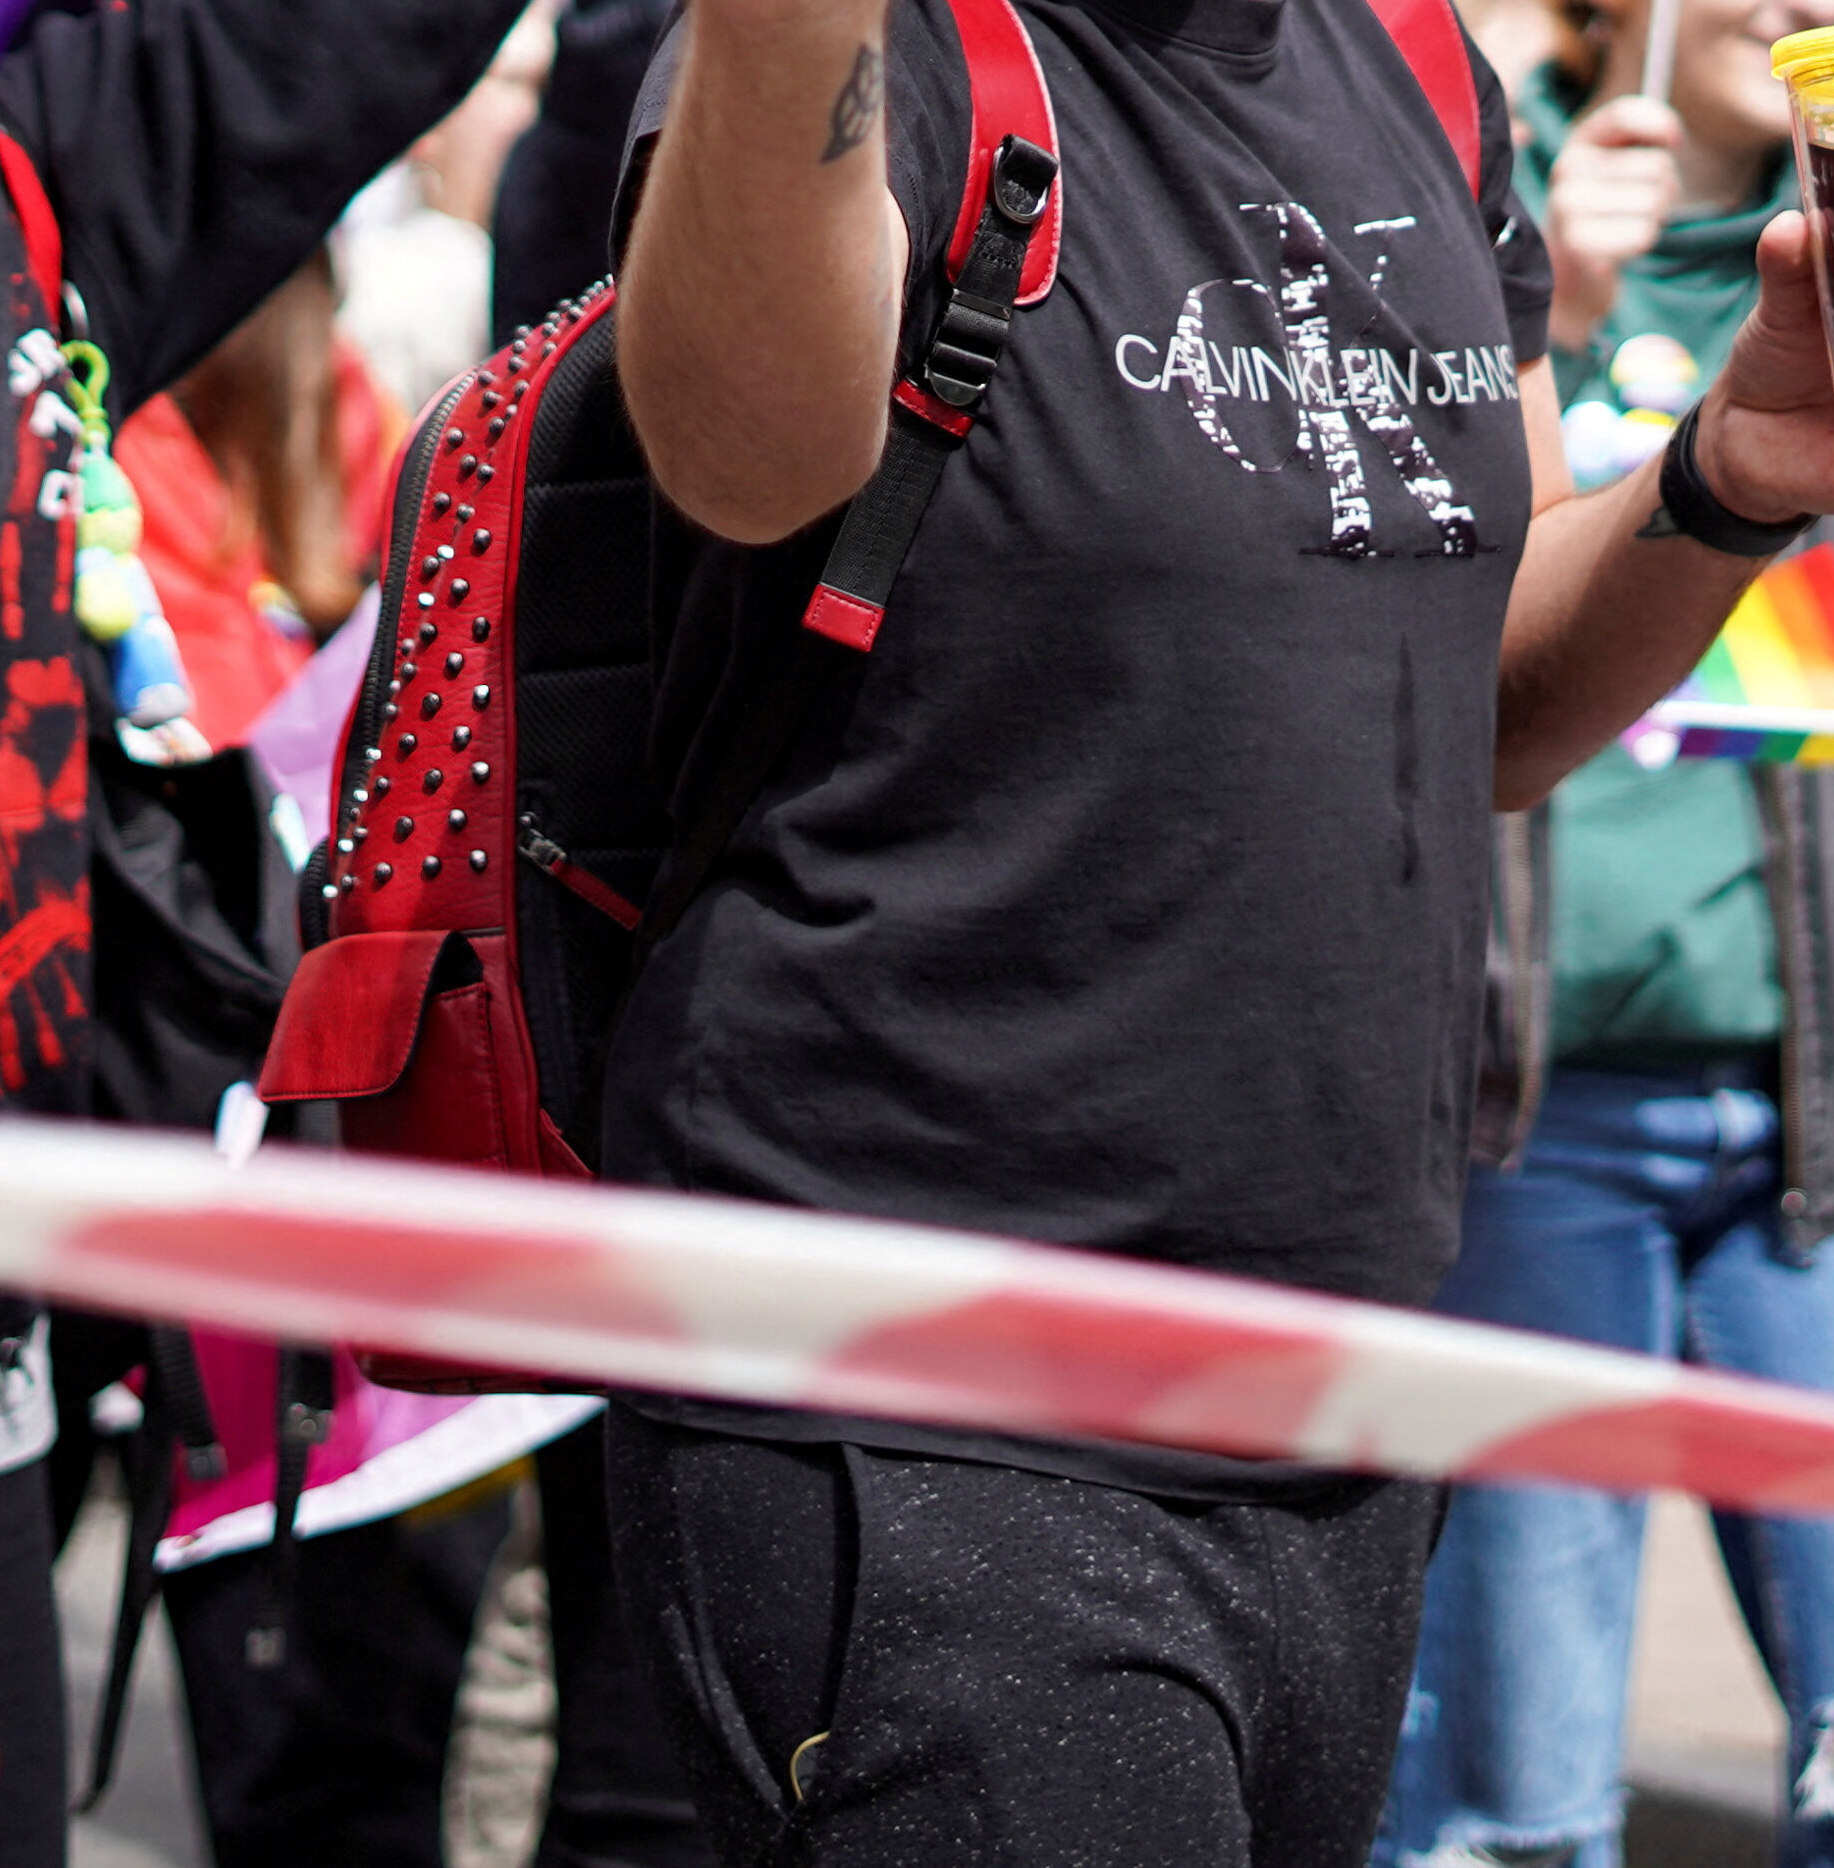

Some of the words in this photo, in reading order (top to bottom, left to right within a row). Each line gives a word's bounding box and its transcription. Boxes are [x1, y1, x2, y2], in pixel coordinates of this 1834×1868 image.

[1114, 333, 1298, 403] CALVIN
[1288, 347, 1417, 407] KLEIN
[1426, 343, 1519, 406] JEANS
